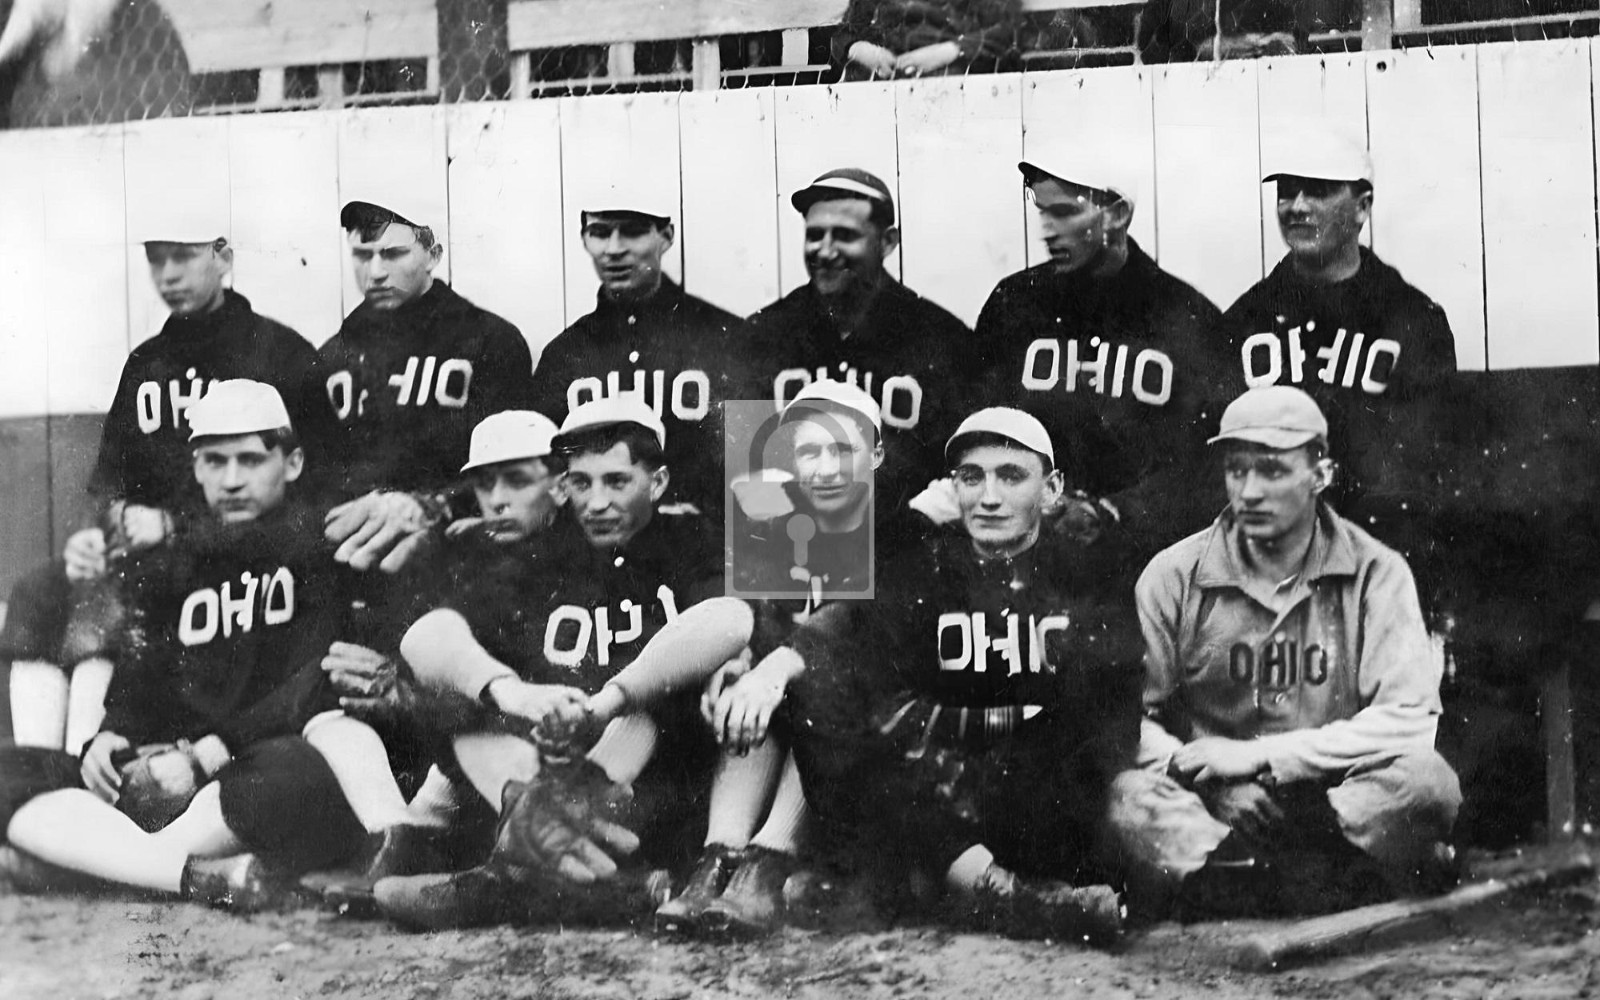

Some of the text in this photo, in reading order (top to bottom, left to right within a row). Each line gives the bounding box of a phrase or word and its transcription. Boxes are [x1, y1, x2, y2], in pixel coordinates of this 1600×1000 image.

[1021, 337, 1174, 406] OHIO
[1241, 326, 1401, 394] OHIO
[178, 566, 295, 647] OHIO
[1229, 640, 1328, 686] OHIO
